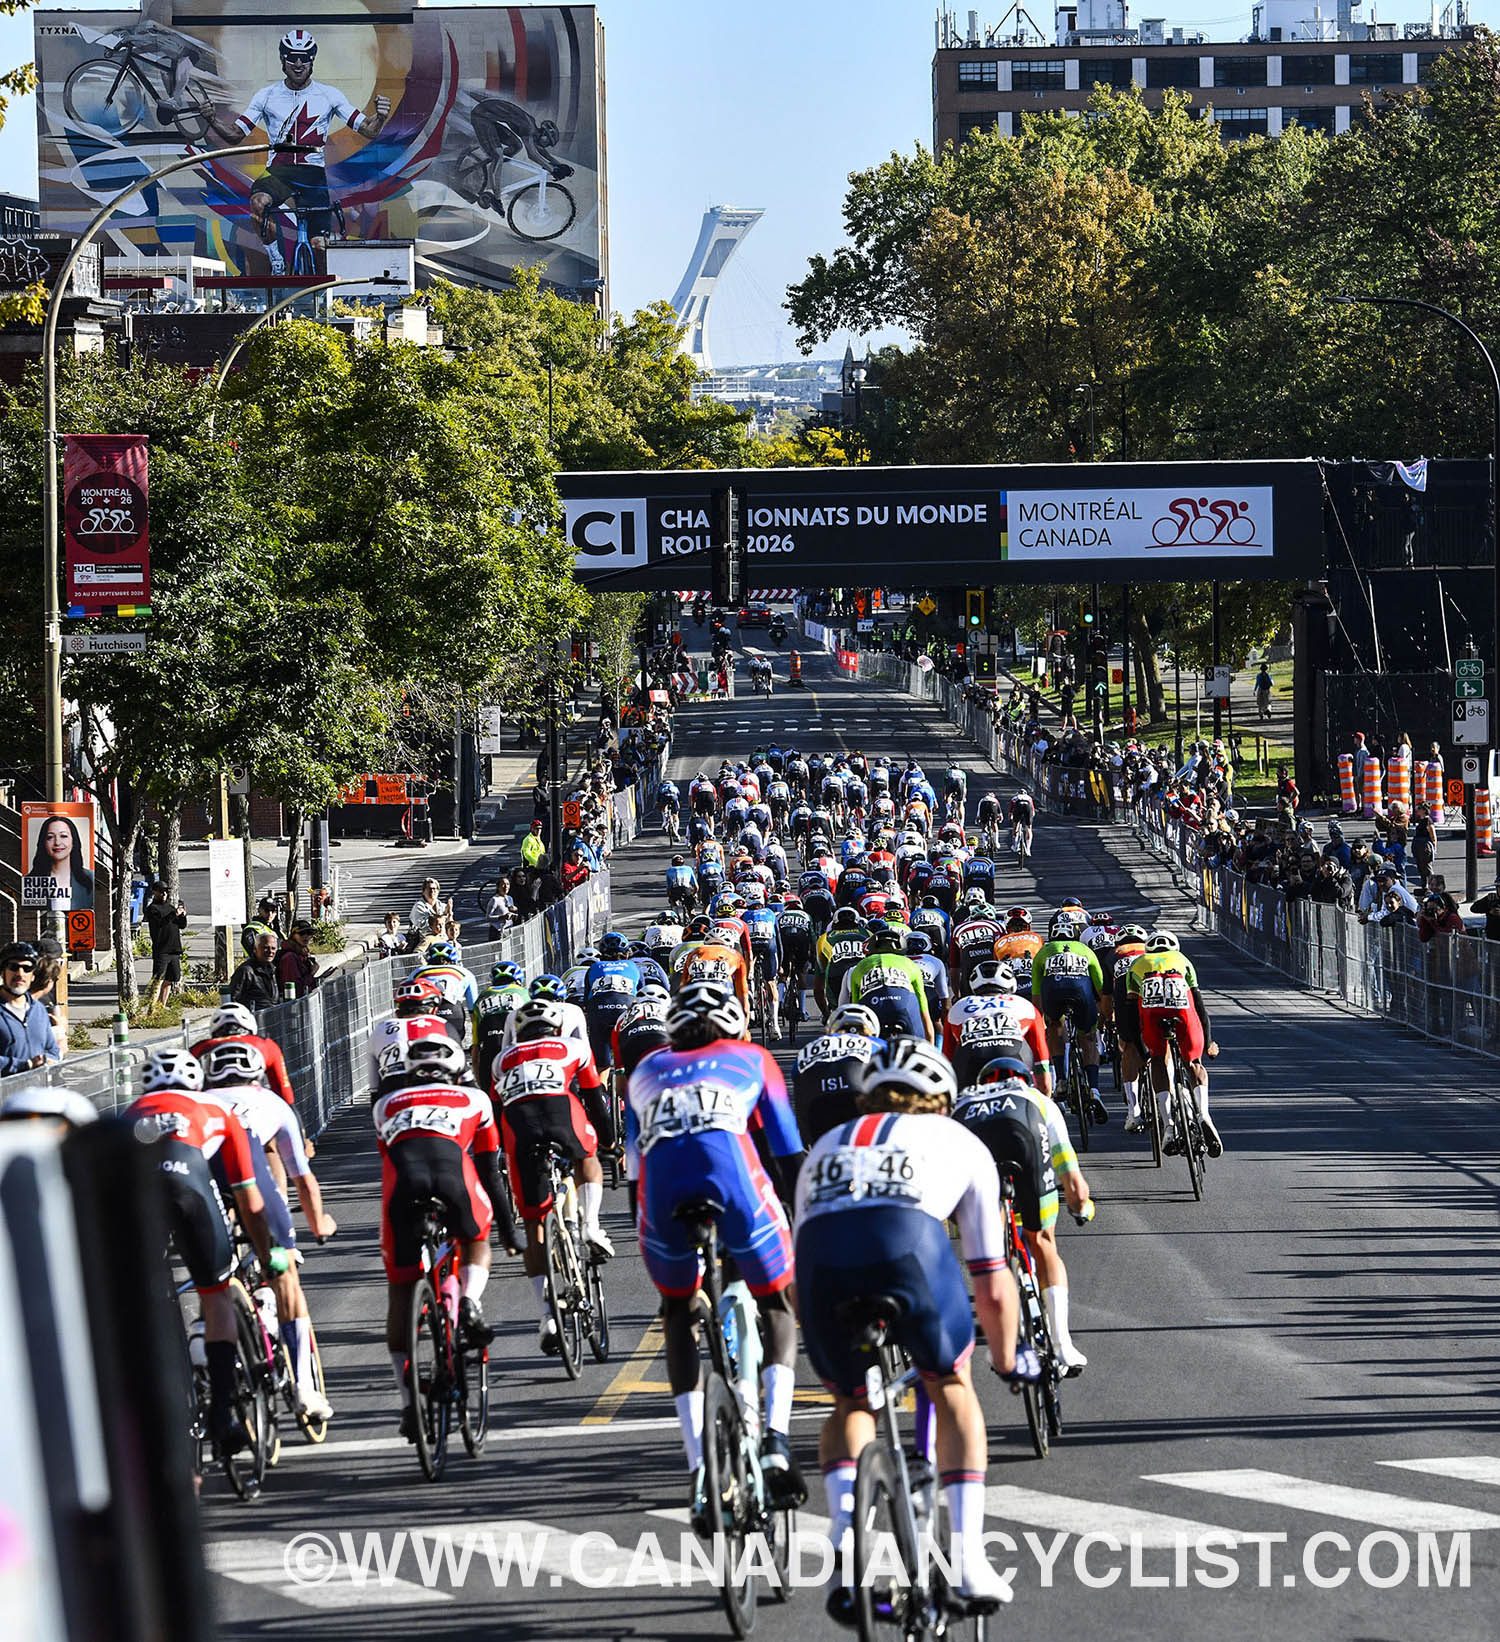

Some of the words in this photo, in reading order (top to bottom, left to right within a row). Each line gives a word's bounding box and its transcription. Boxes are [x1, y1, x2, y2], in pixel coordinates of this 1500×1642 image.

[40, 26, 77, 35] TYXNA
[81, 488, 132, 497] MONTRÉAL
[660, 506, 850, 529] CHAIONNATS
[857, 507, 889, 525] DU
[897, 504, 987, 524] MONDE
[1019, 497, 1143, 521] MONTRÉAL
[562, 511, 636, 556] CI
[1019, 528, 1112, 548] CANADA
[747, 534, 795, 553] 2026
[77, 565, 94, 573] UCI
[89, 641, 142, 650] Hutchison
[24, 877, 57, 888] RUBA
[23, 888, 71, 899] GHAZAL
[965, 1017, 990, 1033] 123
[838, 1037, 868, 1050] 169
[972, 1039, 1014, 1049] PORTUGAL
[535, 1064, 554, 1079] 75
[658, 1060, 718, 1080] HAITI
[821, 1076, 849, 1091] ISL
[879, 1155, 914, 1181] 46
